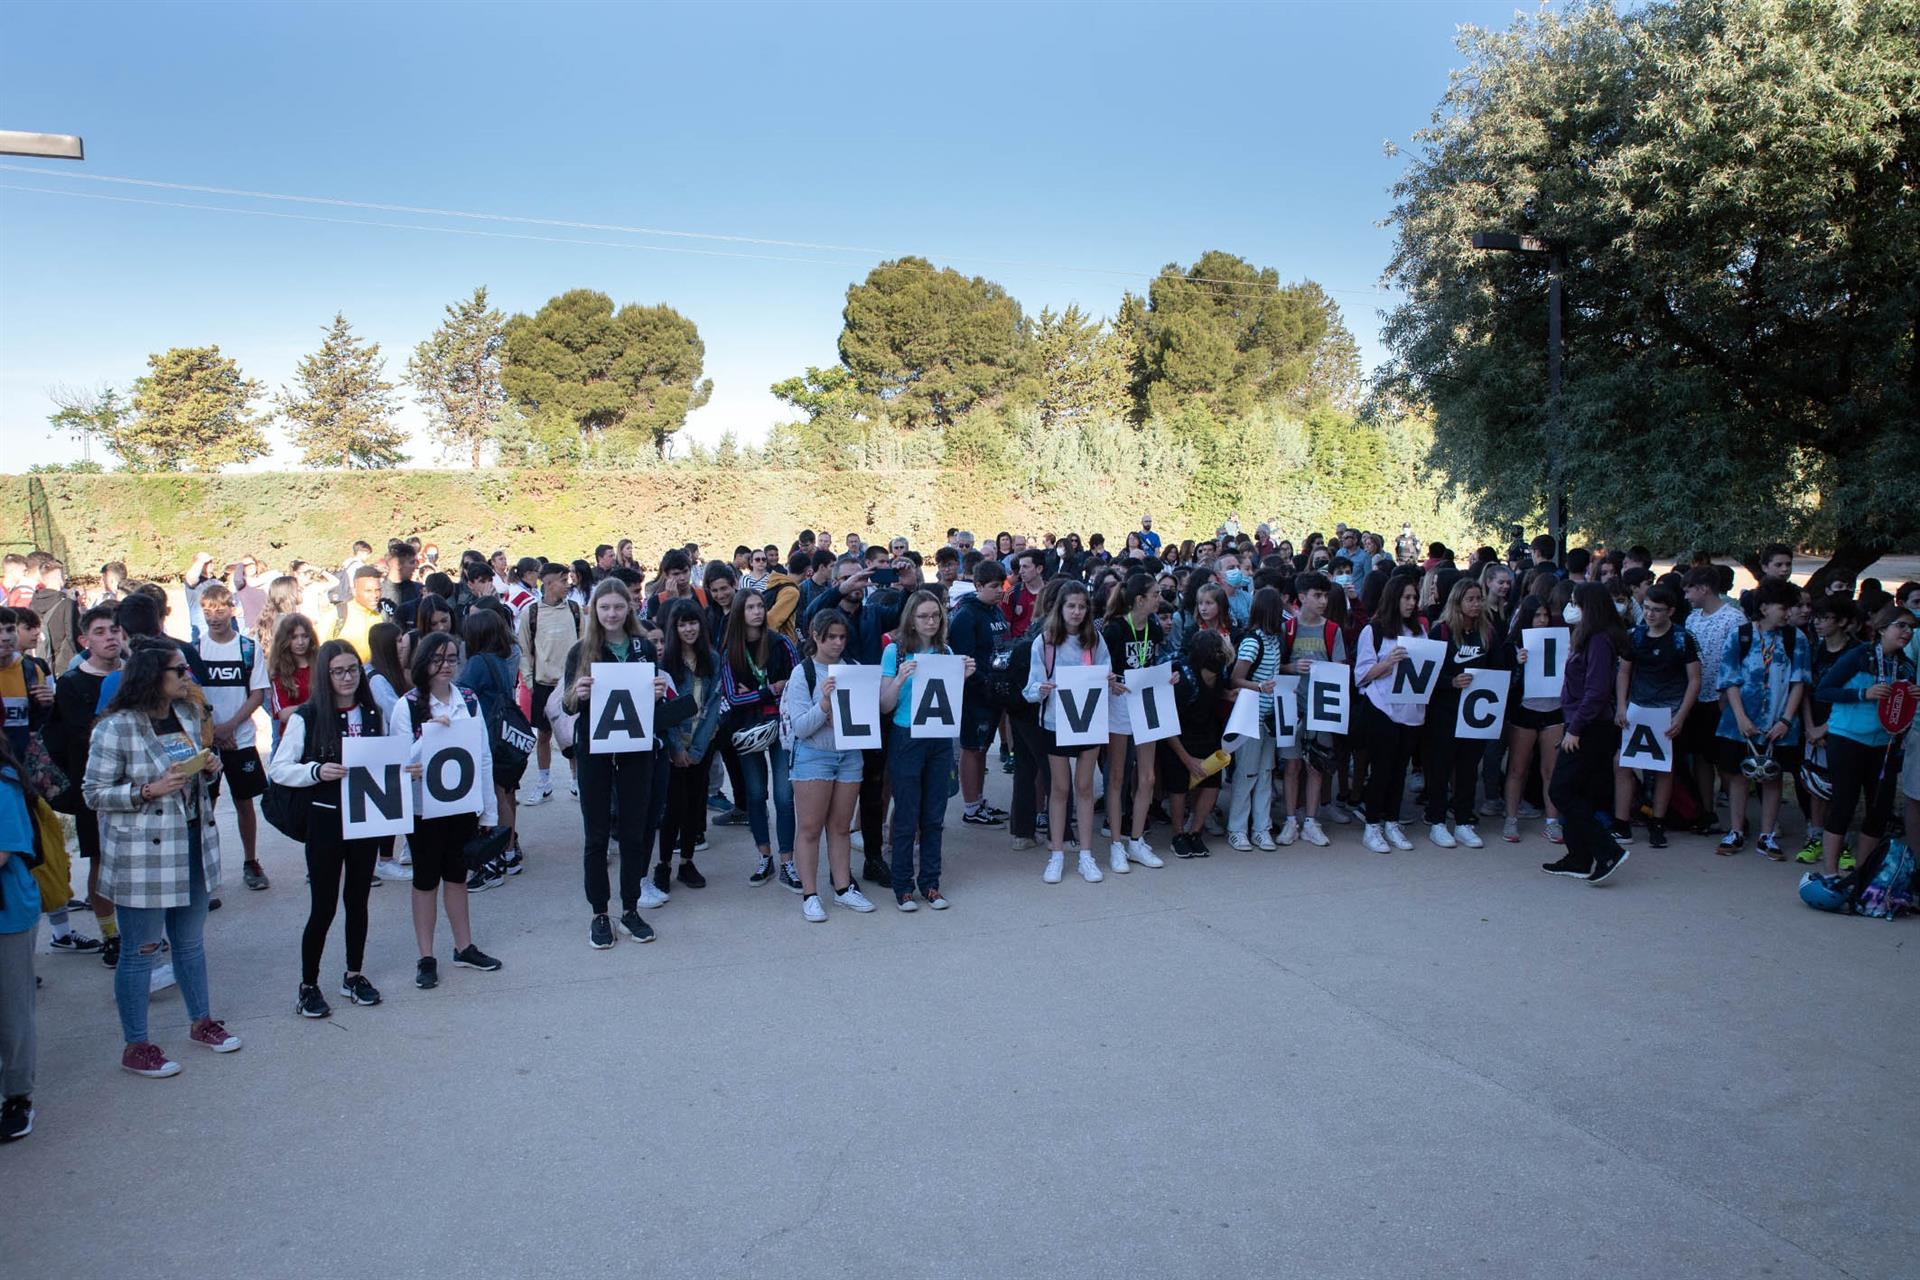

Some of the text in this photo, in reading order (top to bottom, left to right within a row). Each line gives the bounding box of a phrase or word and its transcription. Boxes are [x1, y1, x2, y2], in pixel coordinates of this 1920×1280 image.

[1459, 645, 1481, 657] NIKE
[1544, 638, 1556, 677] I
[1392, 657, 1435, 694] N
[593, 690, 645, 740] A
[837, 689, 871, 736] L
[913, 679, 955, 725] A
[1058, 688, 1102, 733] V
[1142, 686, 1160, 729] I
[1277, 696, 1293, 736] L
[1314, 681, 1341, 722] E
[1463, 689, 1499, 728] C
[501, 720, 537, 754] VANS
[1623, 724, 1665, 761] A
[346, 764, 403, 823] N
[426, 747, 474, 802] O
